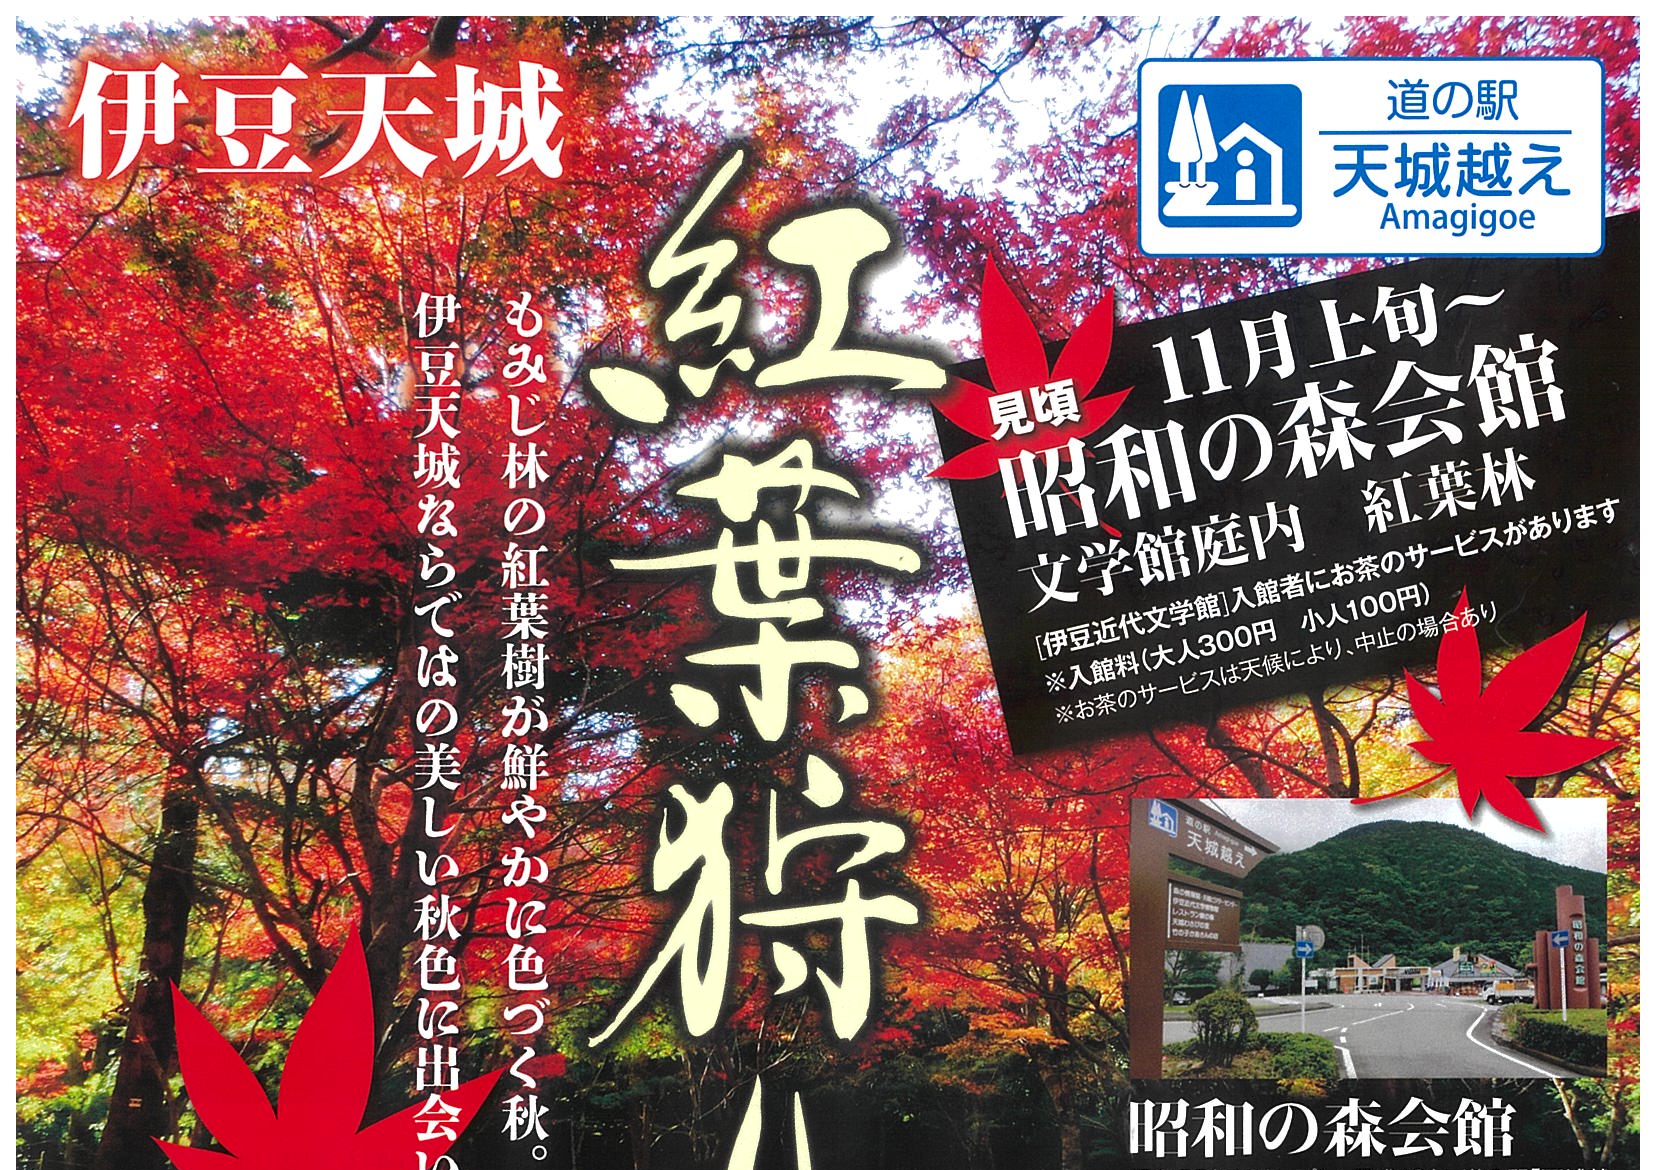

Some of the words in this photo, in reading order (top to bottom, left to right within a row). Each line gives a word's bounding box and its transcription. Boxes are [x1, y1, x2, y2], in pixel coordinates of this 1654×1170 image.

[69, 61, 565, 180] 伊豆天城
[1387, 79, 1519, 122] 道の駅
[1332, 142, 1571, 199] 天城越え
[1379, 203, 1537, 238] Amagigoe
[988, 378, 1082, 440] 見頃
[998, 333, 1567, 539] 昭和の森会館
[1018, 502, 1306, 614] 文学館庭内
[1361, 447, 1537, 534] 紅葉林
[500, 291, 550, 1161] もみじ林の紅葉樹が鮮やかに色づく秋。
[1186, 829, 1246, 869] 天城越え
[1128, 1096, 1517, 1159] 昭和の森会館
